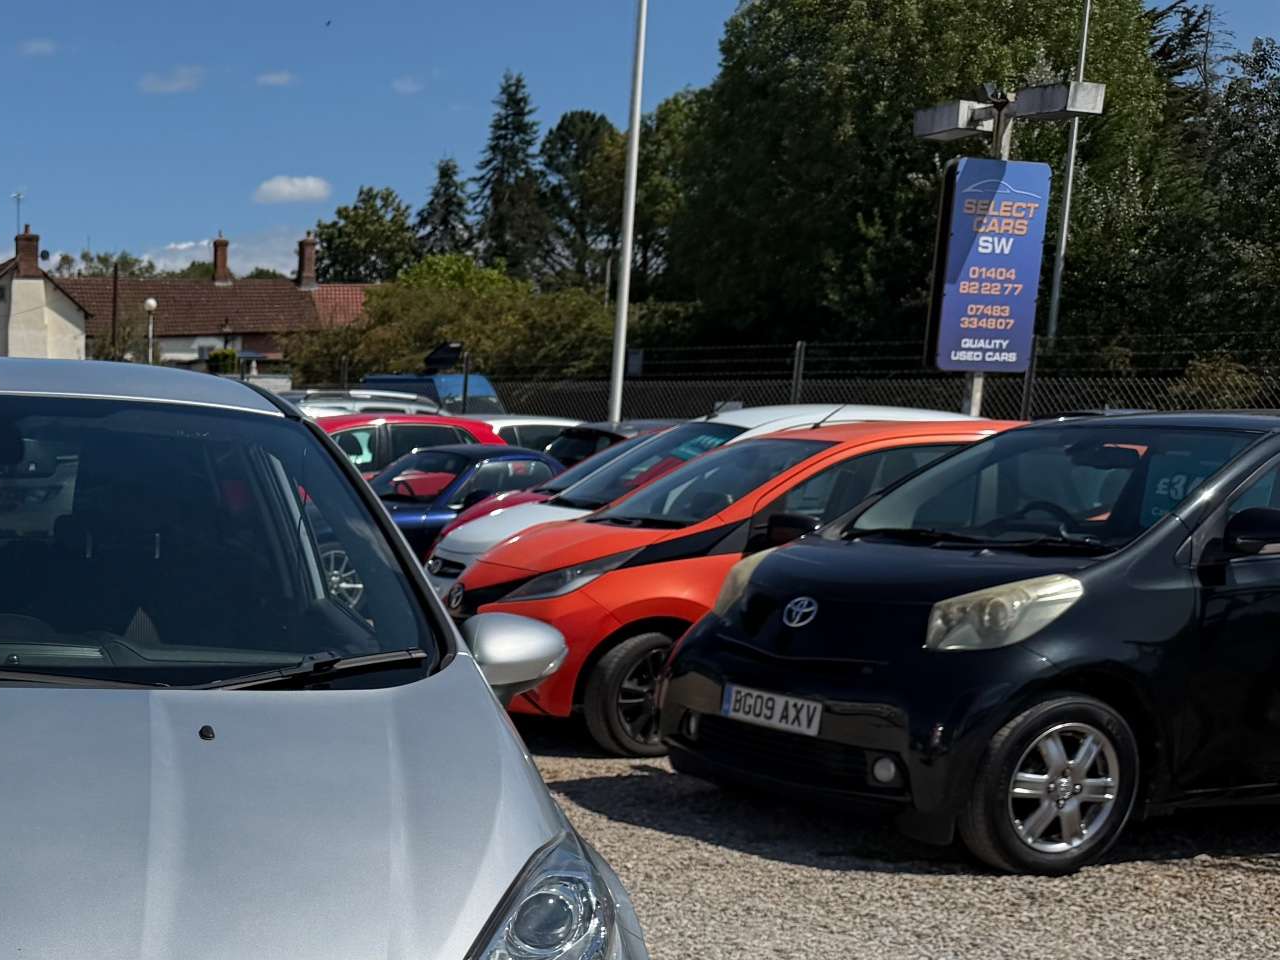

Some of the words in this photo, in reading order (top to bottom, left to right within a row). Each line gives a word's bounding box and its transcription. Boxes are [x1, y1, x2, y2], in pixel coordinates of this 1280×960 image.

[963, 199, 1040, 218] SELECT
[972, 216, 1029, 236] CARS
[977, 236, 1014, 254] SW
[969, 266, 1017, 281] 01404
[967, 303, 1011, 317] 07483
[959, 316, 1016, 330] 334807
[960, 337, 1010, 349] QUALITY
[950, 349, 983, 361] USED
[984, 351, 1018, 362] CARS
[732, 688, 776, 720] BG09
[778, 700, 818, 729] AXV
